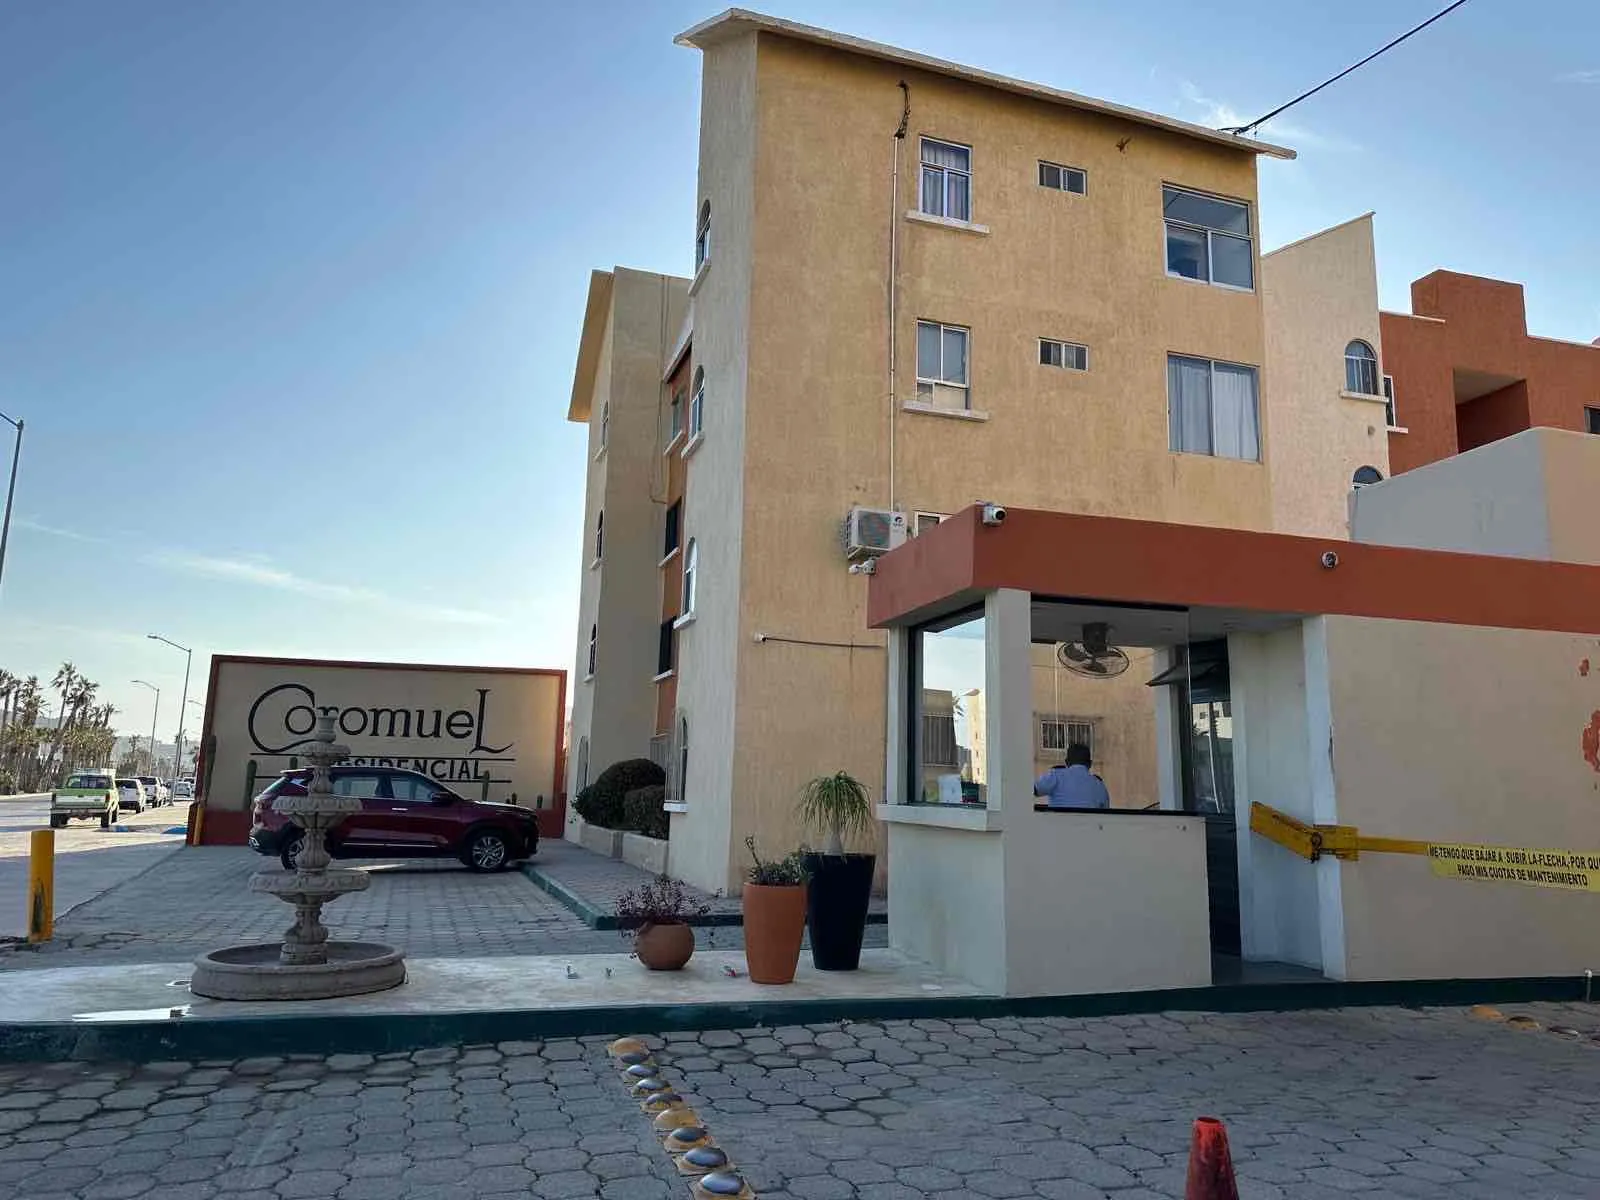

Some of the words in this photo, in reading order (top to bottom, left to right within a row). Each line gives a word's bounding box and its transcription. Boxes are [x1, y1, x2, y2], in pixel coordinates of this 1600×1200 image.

[1461, 848, 1474, 861] QUE
[1475, 849, 1497, 862] BAJAR
[1506, 851, 1527, 864] SUBIR
[1457, 863, 1475, 877] PAGO
[1475, 864, 1488, 878] MIS
[1489, 866, 1515, 880] CUOTAS
[1516, 868, 1526, 881] DE
[1527, 868, 1588, 886] MANTENIMIENTO
